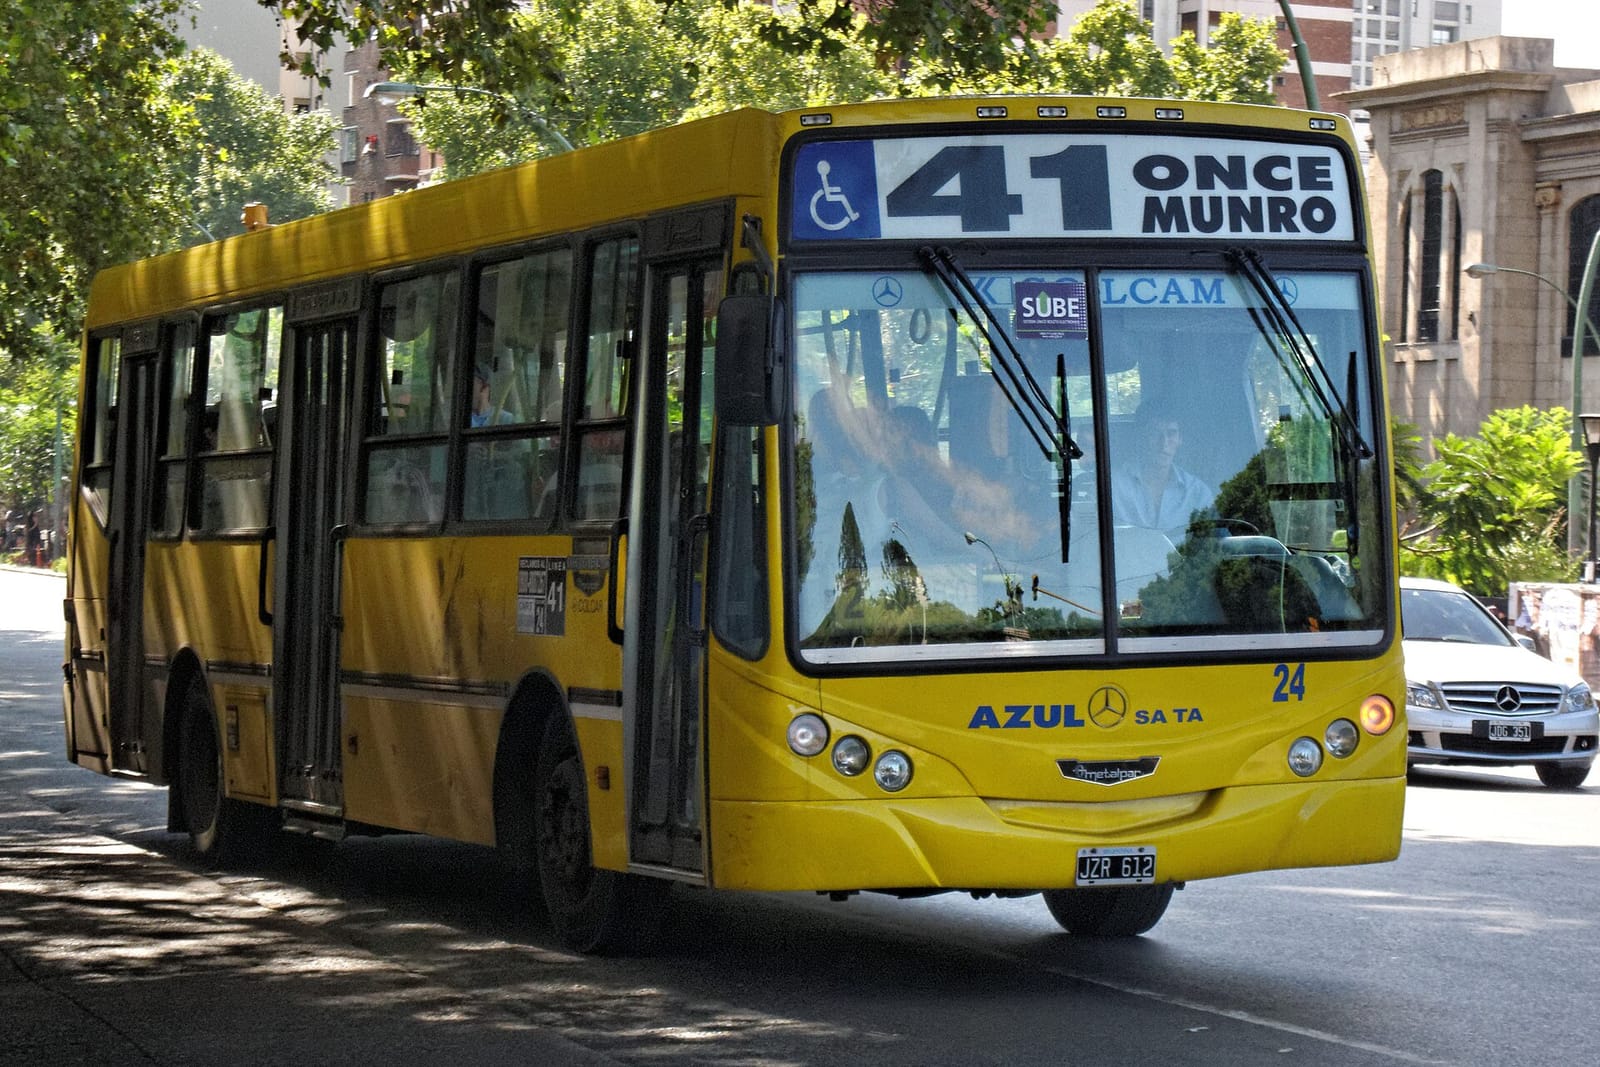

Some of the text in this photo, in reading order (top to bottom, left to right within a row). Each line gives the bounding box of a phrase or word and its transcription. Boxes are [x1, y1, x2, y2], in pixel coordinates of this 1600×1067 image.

[886, 144, 1113, 232] 41
[1132, 154, 1332, 192] ONCE
[1141, 196, 1337, 234] MUNRO
[1022, 297, 1080, 318] SUBE
[547, 581, 564, 613] 41
[1273, 662, 1306, 702] 24
[968, 705, 1085, 729] AZUL
[1512, 726, 1529, 738] 351
[1079, 856, 1153, 879] JZR 612
